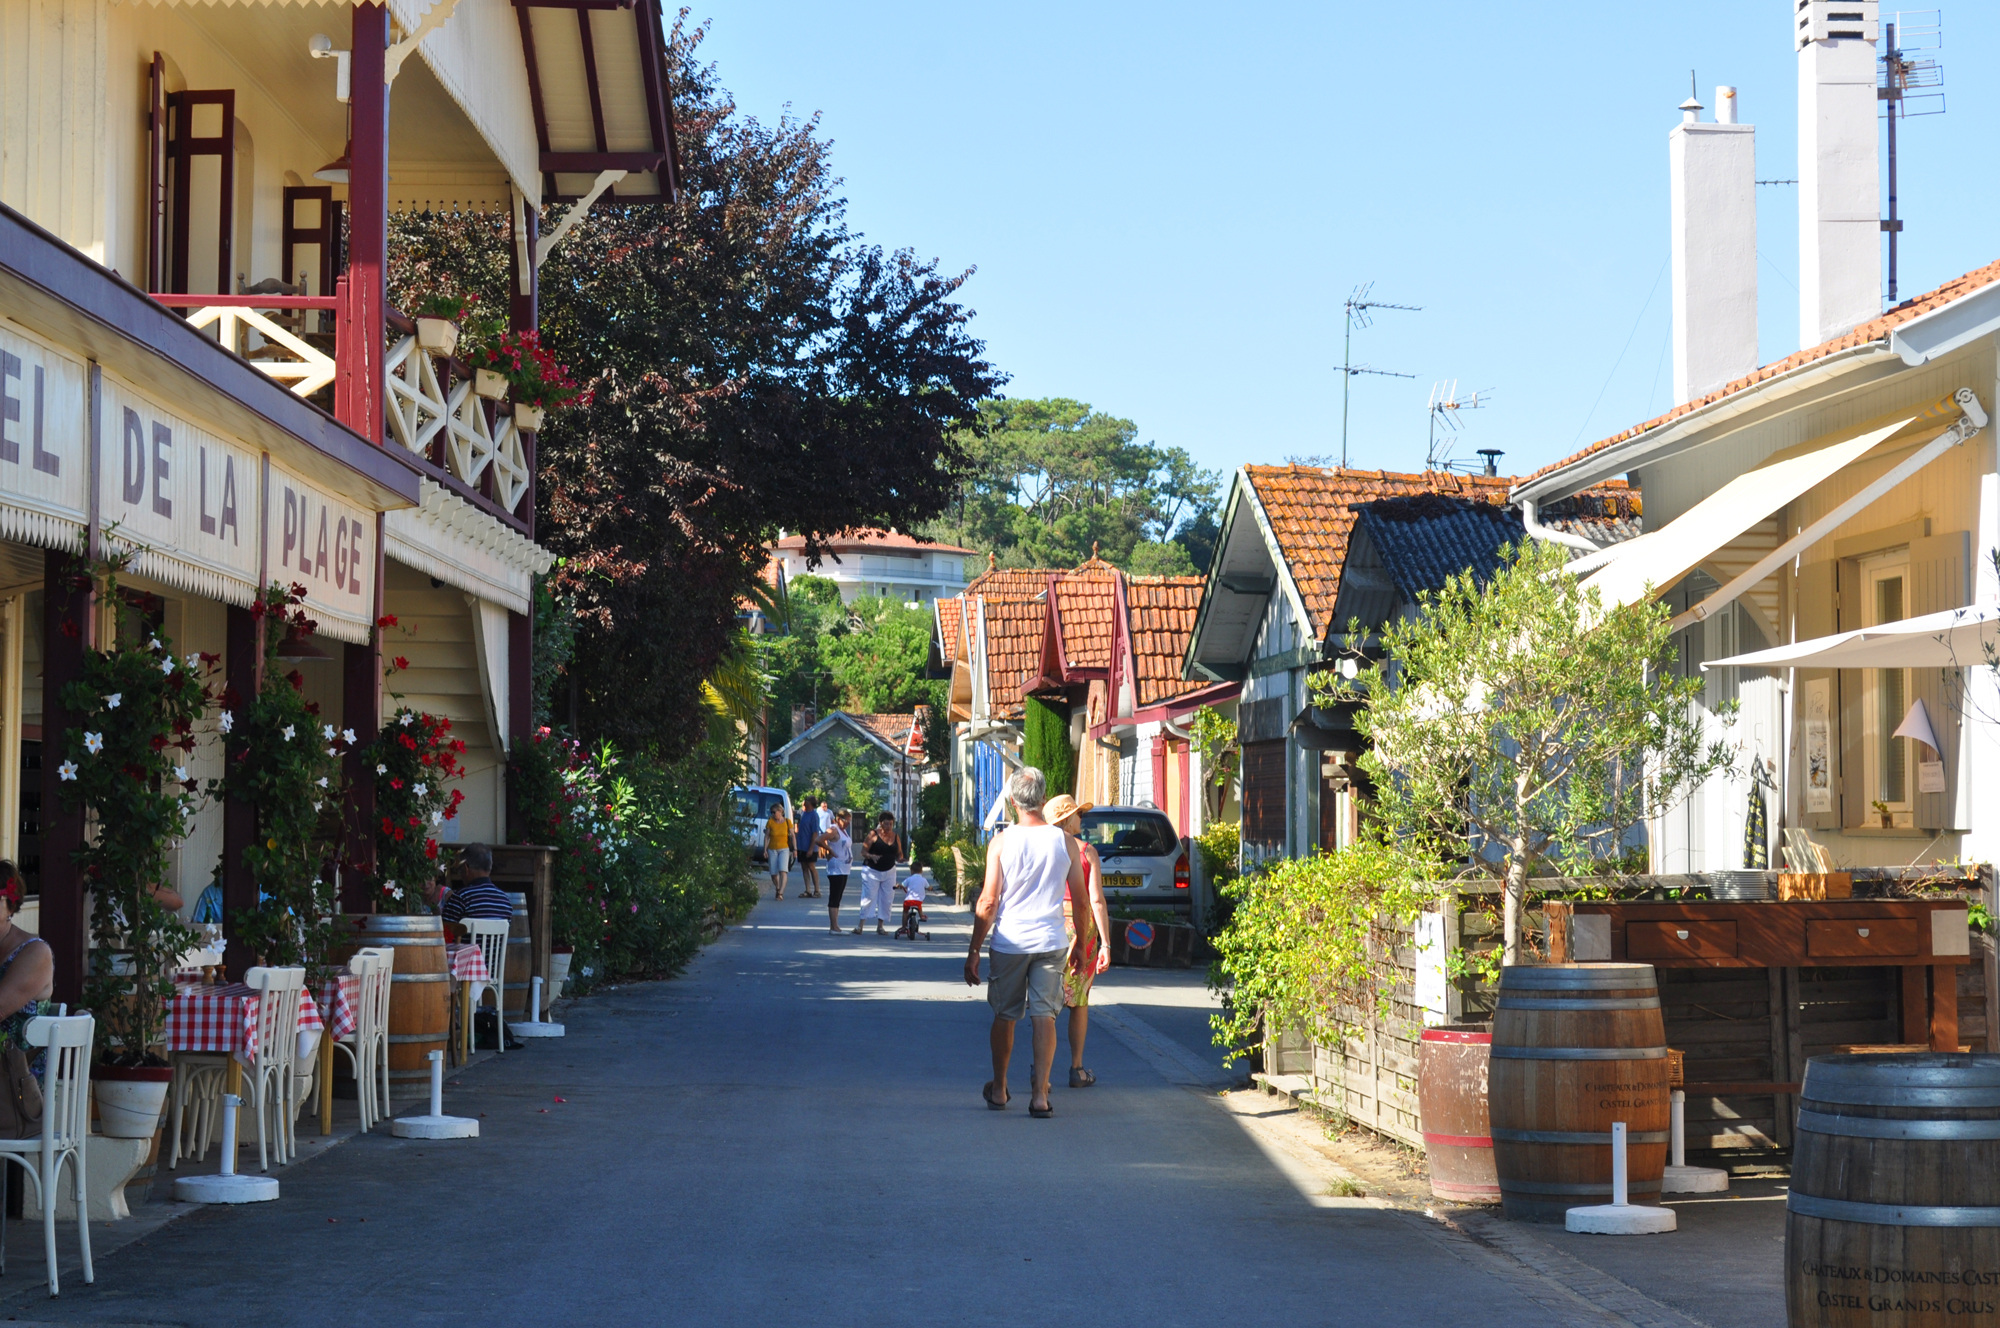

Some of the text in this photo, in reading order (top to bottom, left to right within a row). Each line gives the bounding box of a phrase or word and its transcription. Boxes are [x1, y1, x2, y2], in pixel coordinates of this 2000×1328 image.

[122, 405, 172, 520] DE
[199, 445, 238, 547] LA
[282, 485, 363, 596] PLAGE
[1131, 876, 1141, 885] 33
[1600, 1099, 1632, 1109] CASTEL
[1802, 1260, 1862, 1280] CHATEAUX
[1864, 1269, 1873, 1281] &
[1874, 1267, 1960, 1285] DOMAINES
[1817, 1290, 1995, 1315] CASTEL GRANDS CRUS
